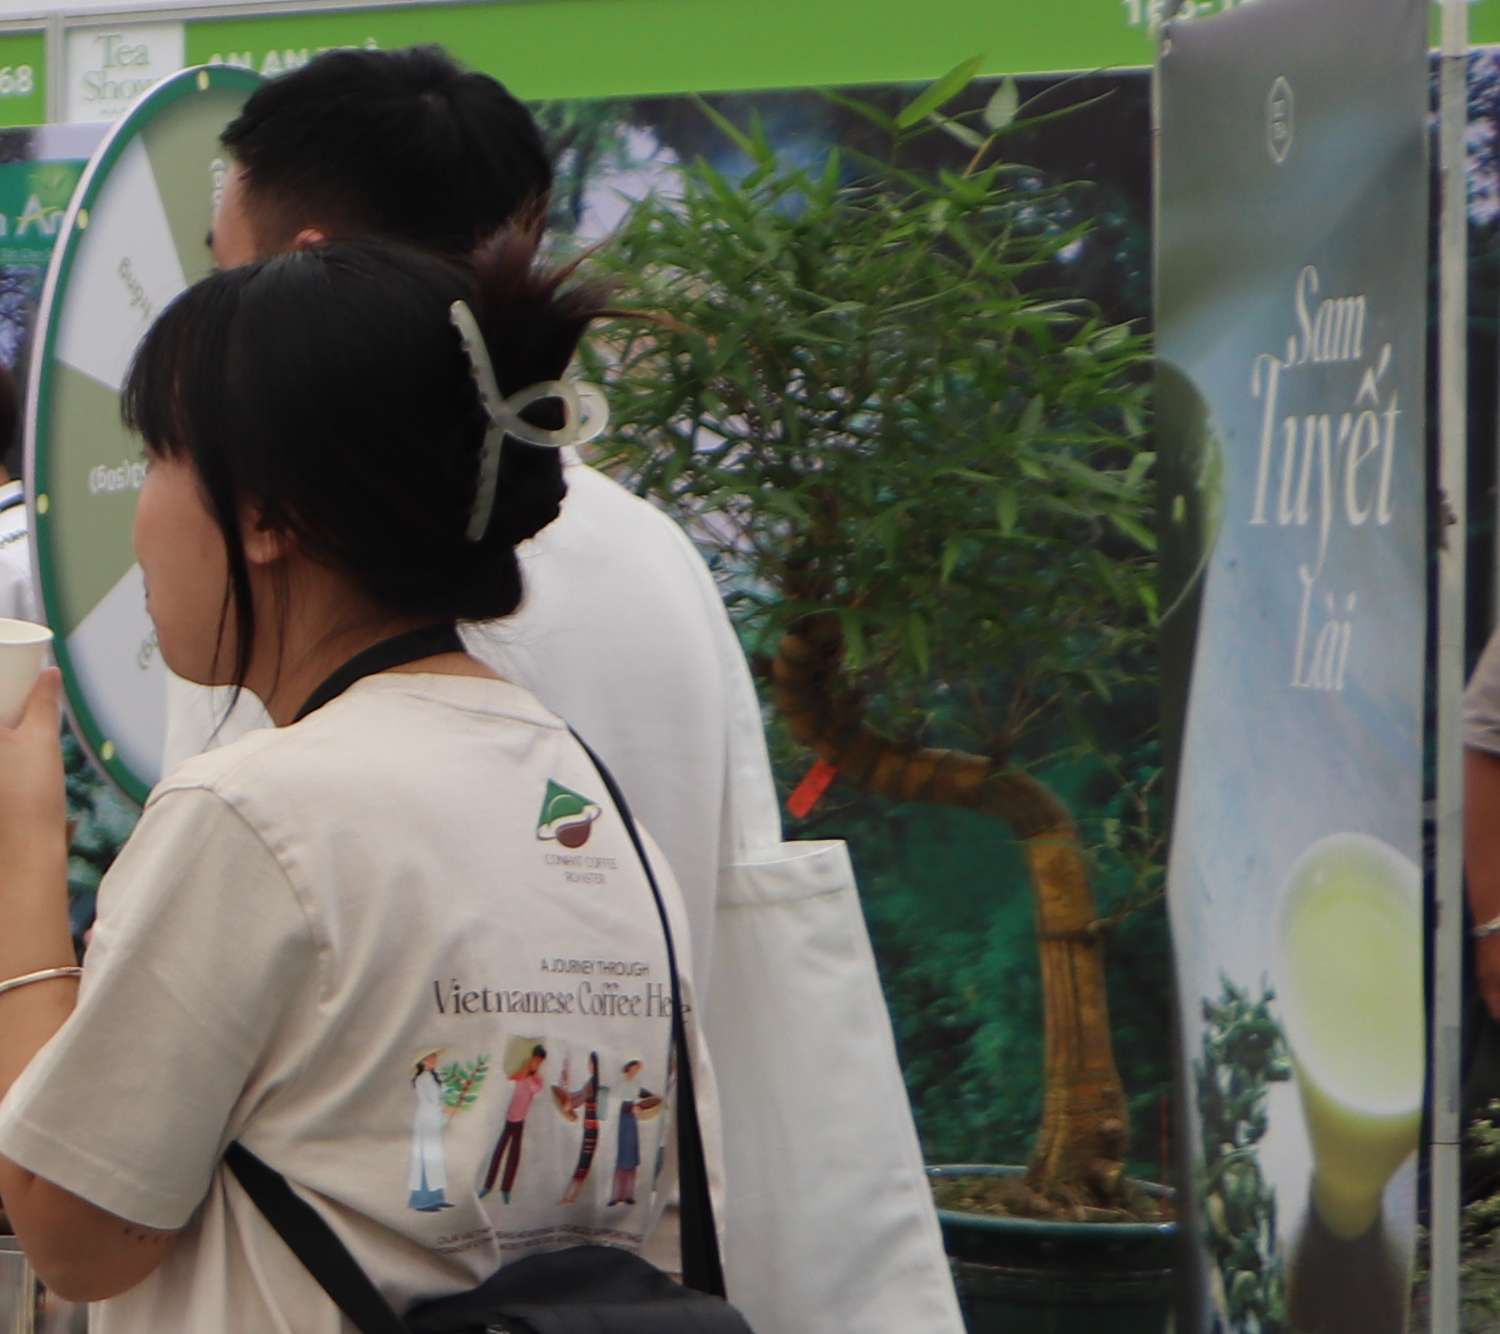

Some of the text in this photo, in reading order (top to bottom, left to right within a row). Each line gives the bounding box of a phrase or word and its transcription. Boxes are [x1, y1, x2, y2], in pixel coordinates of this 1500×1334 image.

[96, 35, 150, 69] Tea
[1285, 263, 1367, 368] Sam
[1249, 342, 1403, 583] Tuyết
[1291, 562, 1356, 693] Lài
[433, 979, 641, 1017] Vietnamese Coffee
[541, 958, 649, 976] A JOURNEY THROUGH
